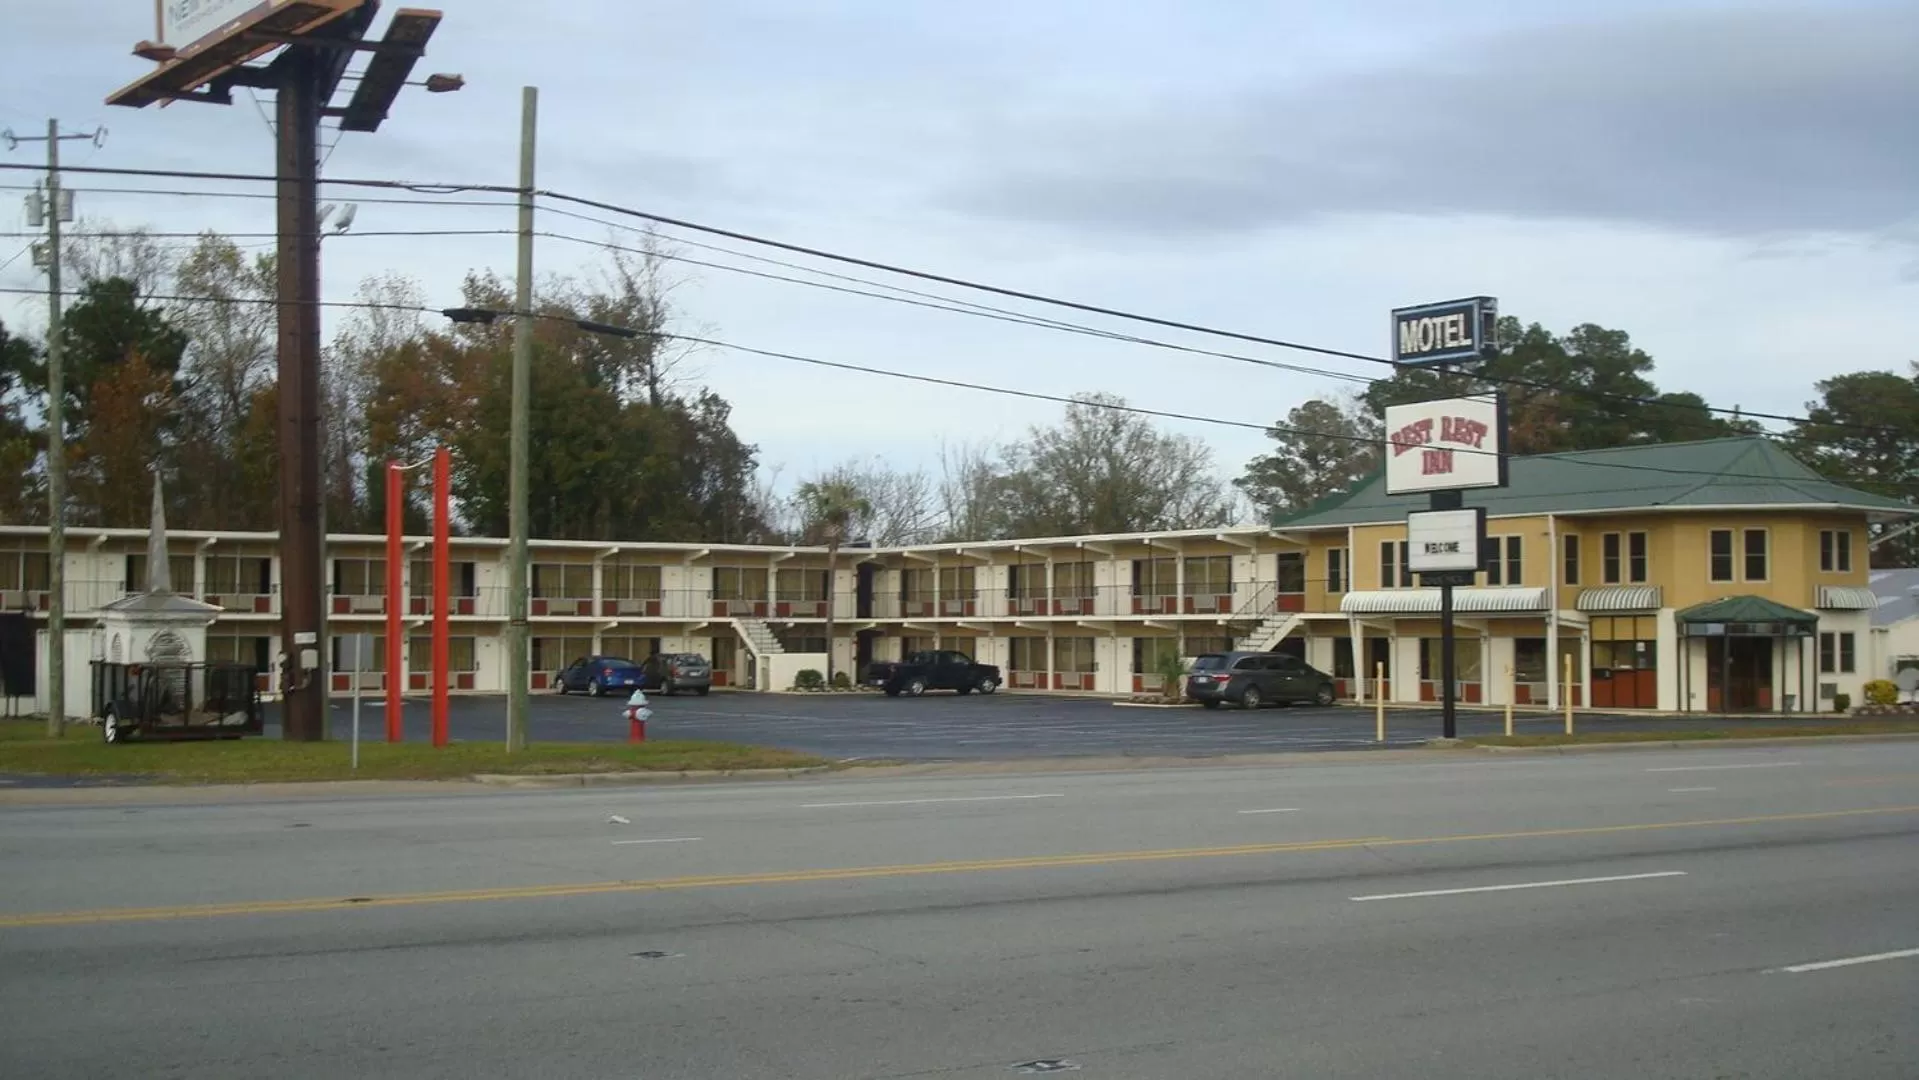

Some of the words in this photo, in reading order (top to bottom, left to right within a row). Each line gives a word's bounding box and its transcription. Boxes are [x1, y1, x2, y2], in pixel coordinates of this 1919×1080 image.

[1399, 313, 1473, 354] MOTEL
[1390, 417, 1434, 458] BEST
[1440, 416, 1489, 450] REST
[1421, 450, 1454, 476] INN
[1424, 541, 1460, 554] WELCOME
